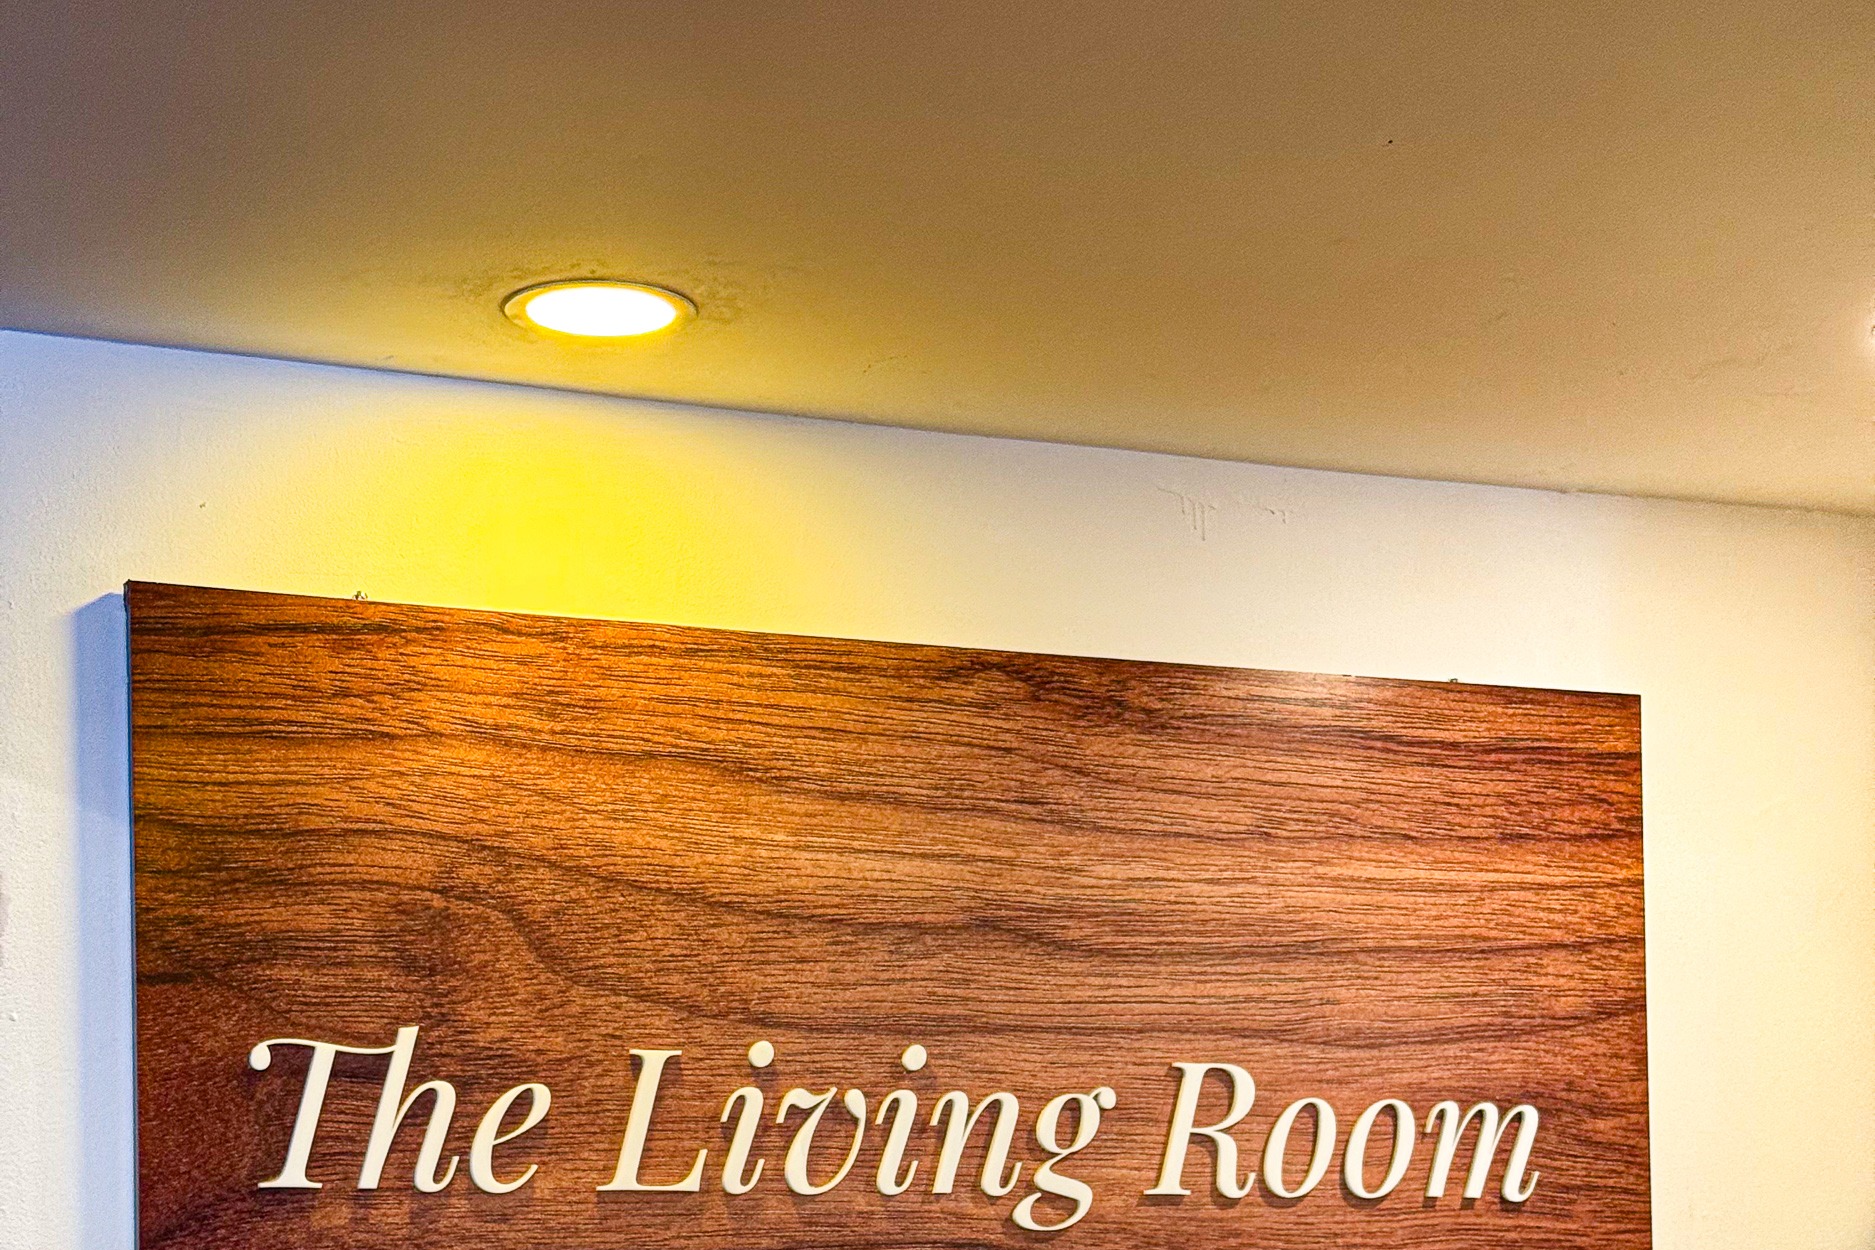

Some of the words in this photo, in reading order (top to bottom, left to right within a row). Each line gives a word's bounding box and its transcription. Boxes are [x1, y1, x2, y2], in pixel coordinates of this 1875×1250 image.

[248, 1025, 551, 1194] The
[596, 1041, 1117, 1232] Living
[1144, 1062, 1539, 1203] Room
